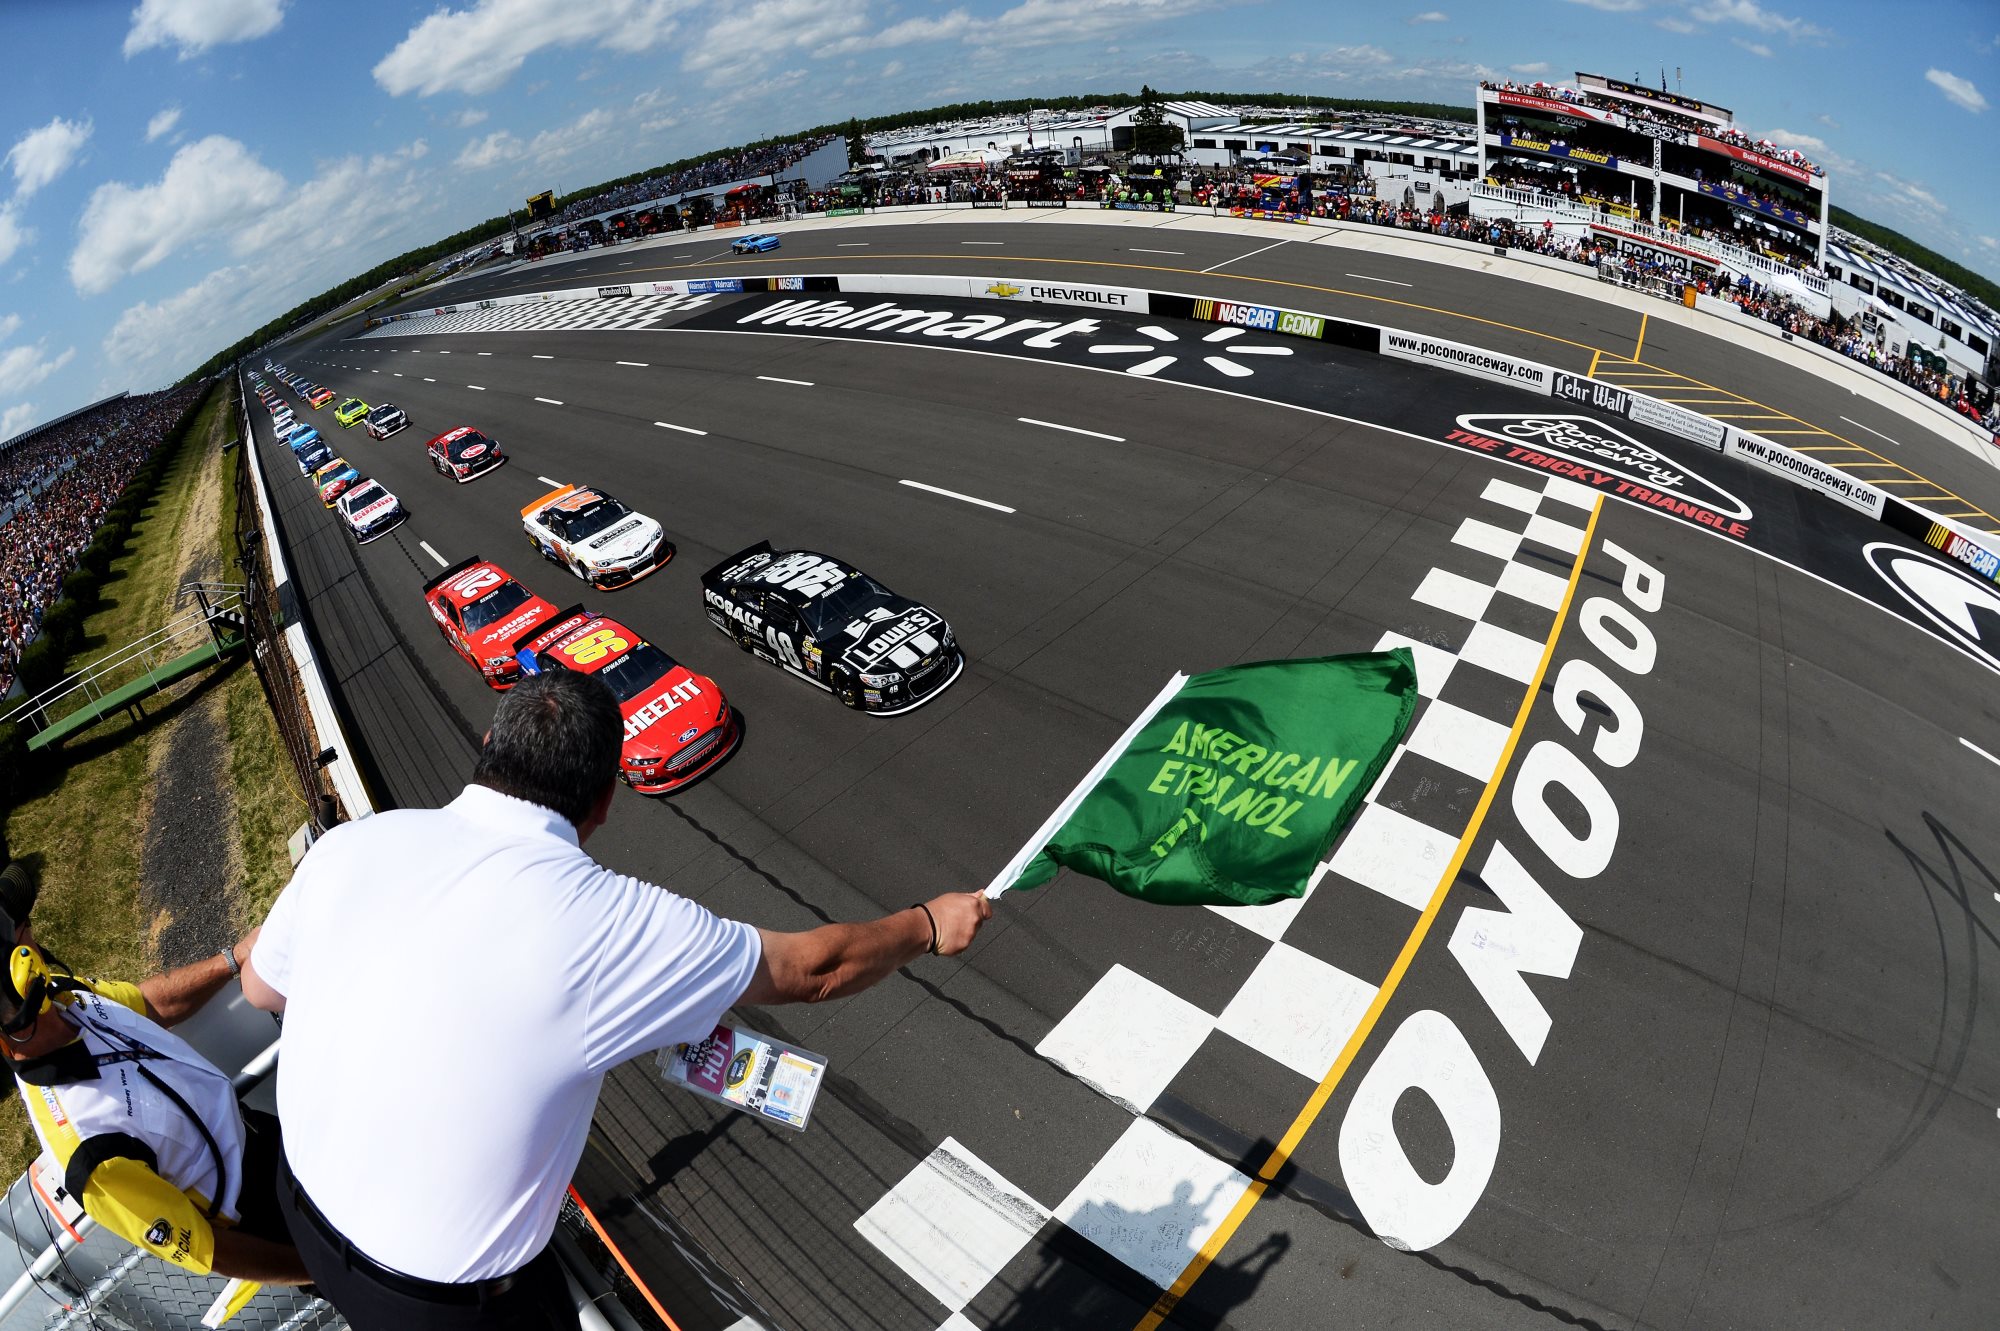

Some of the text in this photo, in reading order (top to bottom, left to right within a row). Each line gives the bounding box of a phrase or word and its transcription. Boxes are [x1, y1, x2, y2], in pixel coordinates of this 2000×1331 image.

[1522, 98, 1545, 107] COATING
[1546, 102, 1570, 111] SYSTEMS
[1556, 115, 1587, 128] POCONO
[1662, 125, 1677, 134] PETTY
[1510, 138, 1550, 152] SUNOCO
[1568, 149, 1609, 164] SUNOCO
[1743, 152, 1758, 162] Built
[1759, 158, 1768, 166] for
[1556, 158, 1587, 172] POCONO
[1730, 160, 1760, 175] POCONO
[688, 281, 706, 290] Walmart
[714, 280, 735, 289] Walmart
[778, 278, 803, 290] NASCAR
[1030, 286, 1129, 306] CHEVROLET
[736, 300, 1101, 348] Walmart
[1388, 335, 1544, 383] www.poconoraceway.com
[1554, 374, 1625, 414] Lehr Wall
[1503, 420, 1685, 487] Raceway
[1551, 420, 1658, 462] Pocono
[1444, 429, 1749, 539] THE TRICKY TRIANGLE
[1737, 436, 1878, 506] www.poconoraceway.com
[453, 568, 502, 599] 20
[765, 555, 848, 599] 48
[821, 582, 845, 599] JOHNSON
[497, 606, 543, 635] HUSKY
[705, 588, 763, 631] KOBALT
[536, 617, 582, 647] CHEEZ-IT
[557, 621, 604, 650] CHEEZ-IT
[743, 624, 764, 639] TOOLS
[852, 612, 931, 663] LOWE'S
[563, 629, 629, 665] 99
[766, 626, 803, 670] 48
[602, 654, 630, 674] EDWARDS
[889, 684, 899, 694] 48
[682, 729, 696, 741] Ford
[678, 740, 719, 772] FUSION
[1160, 721, 1359, 799] AMERICAN
[645, 768, 655, 776] 99
[1338, 538, 1666, 1252] POCONO
[120, 1068, 128, 1087] Wise
[171, 1228, 192, 1263] OFFICIAL
